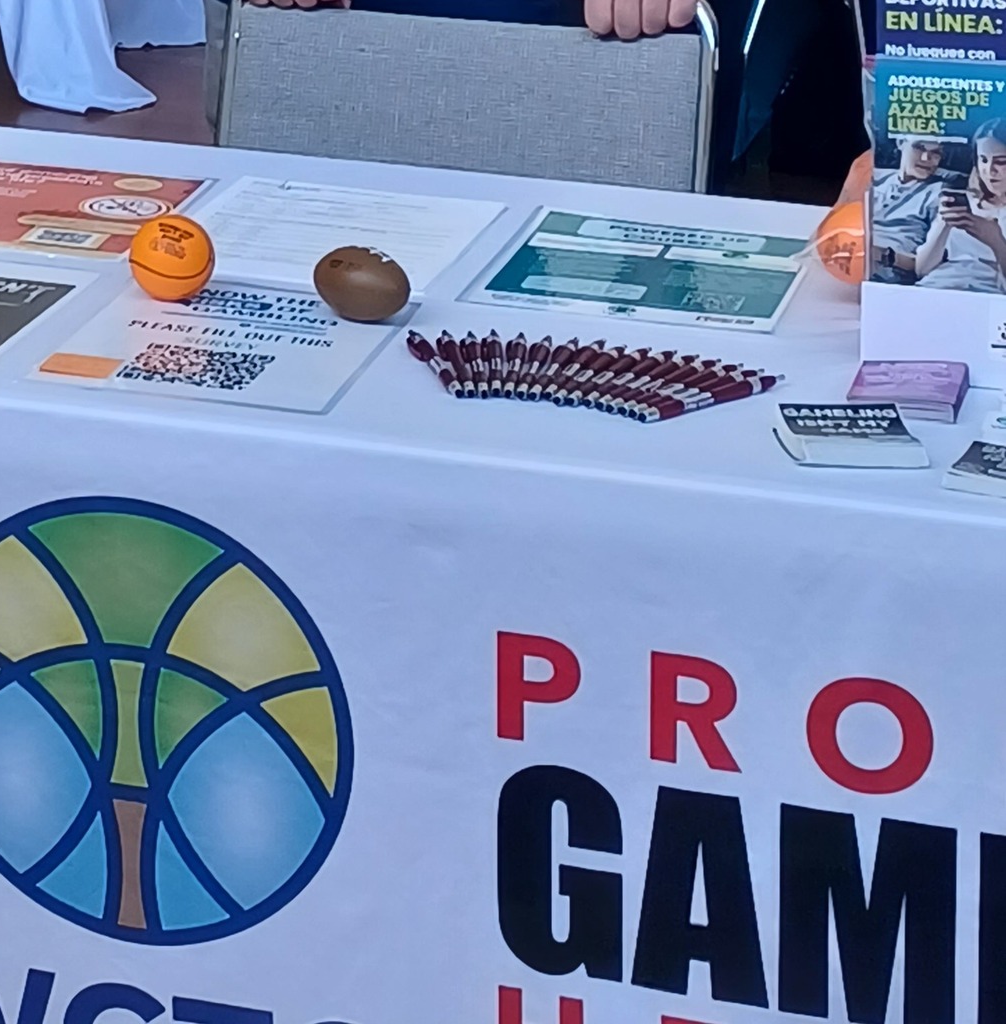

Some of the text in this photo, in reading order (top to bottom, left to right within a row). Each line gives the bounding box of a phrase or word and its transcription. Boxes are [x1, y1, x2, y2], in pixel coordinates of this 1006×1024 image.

[886, 7, 1003, 35] EN LÍNEA:
[885, 43, 905, 57] No
[967, 49, 996, 60] con
[887, 75, 1006, 93] ADOLESCENTES Y
[889, 87, 990, 107] JUEGOS DE
[887, 103, 967, 120] AZAR EN
[199, 288, 267, 300] NOW
[127, 319, 199, 333] PLEASE
[244, 331, 288, 344] OUT
[290, 336, 335, 349] THIS
[783, 407, 897, 418] GAMBLING
[857, 419, 891, 428] MY
[497, 631, 934, 795] PRO
[497, 764, 1006, 1024] GAM
